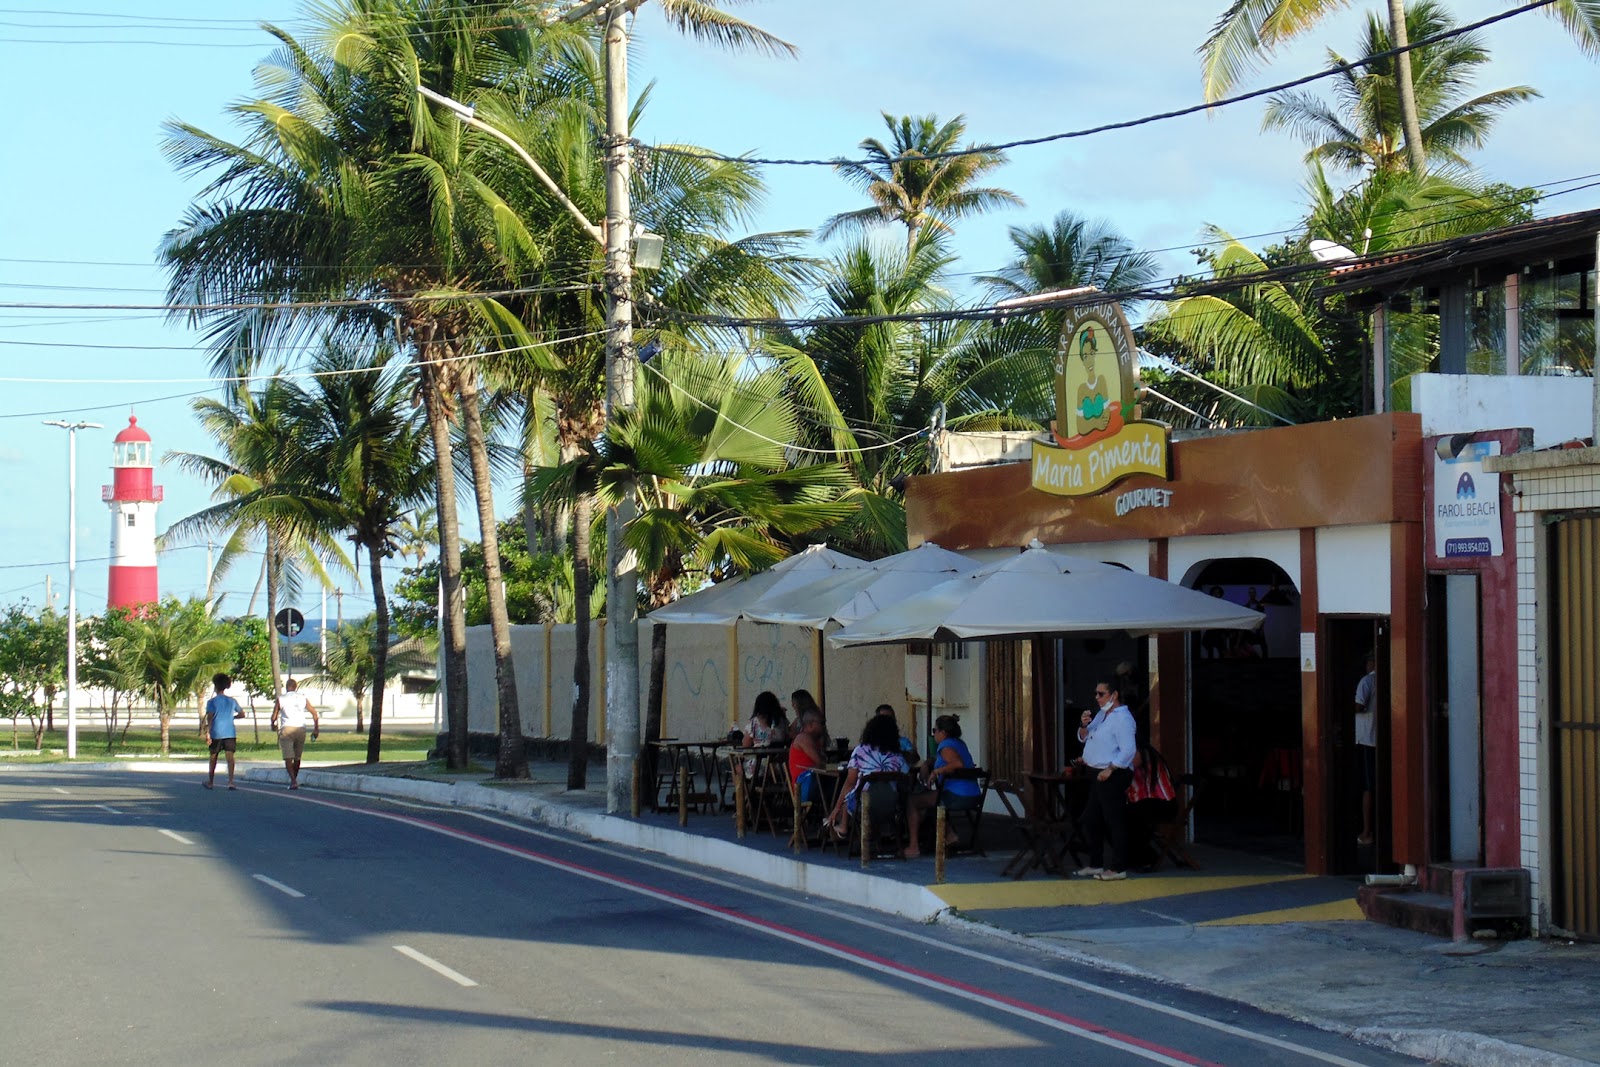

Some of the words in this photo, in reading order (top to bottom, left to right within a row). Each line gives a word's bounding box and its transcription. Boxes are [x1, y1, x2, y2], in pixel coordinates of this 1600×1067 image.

[1056, 333, 1068, 375] BAR
[1066, 319, 1074, 334] &
[1035, 453, 1083, 487] Maria
[1089, 434, 1161, 483] Pimenta
[1115, 488, 1173, 516] GOURMET
[1438, 503, 1465, 518] FAROL
[1467, 502, 1495, 516] BEACH
[1447, 542, 1457, 554] (71)
